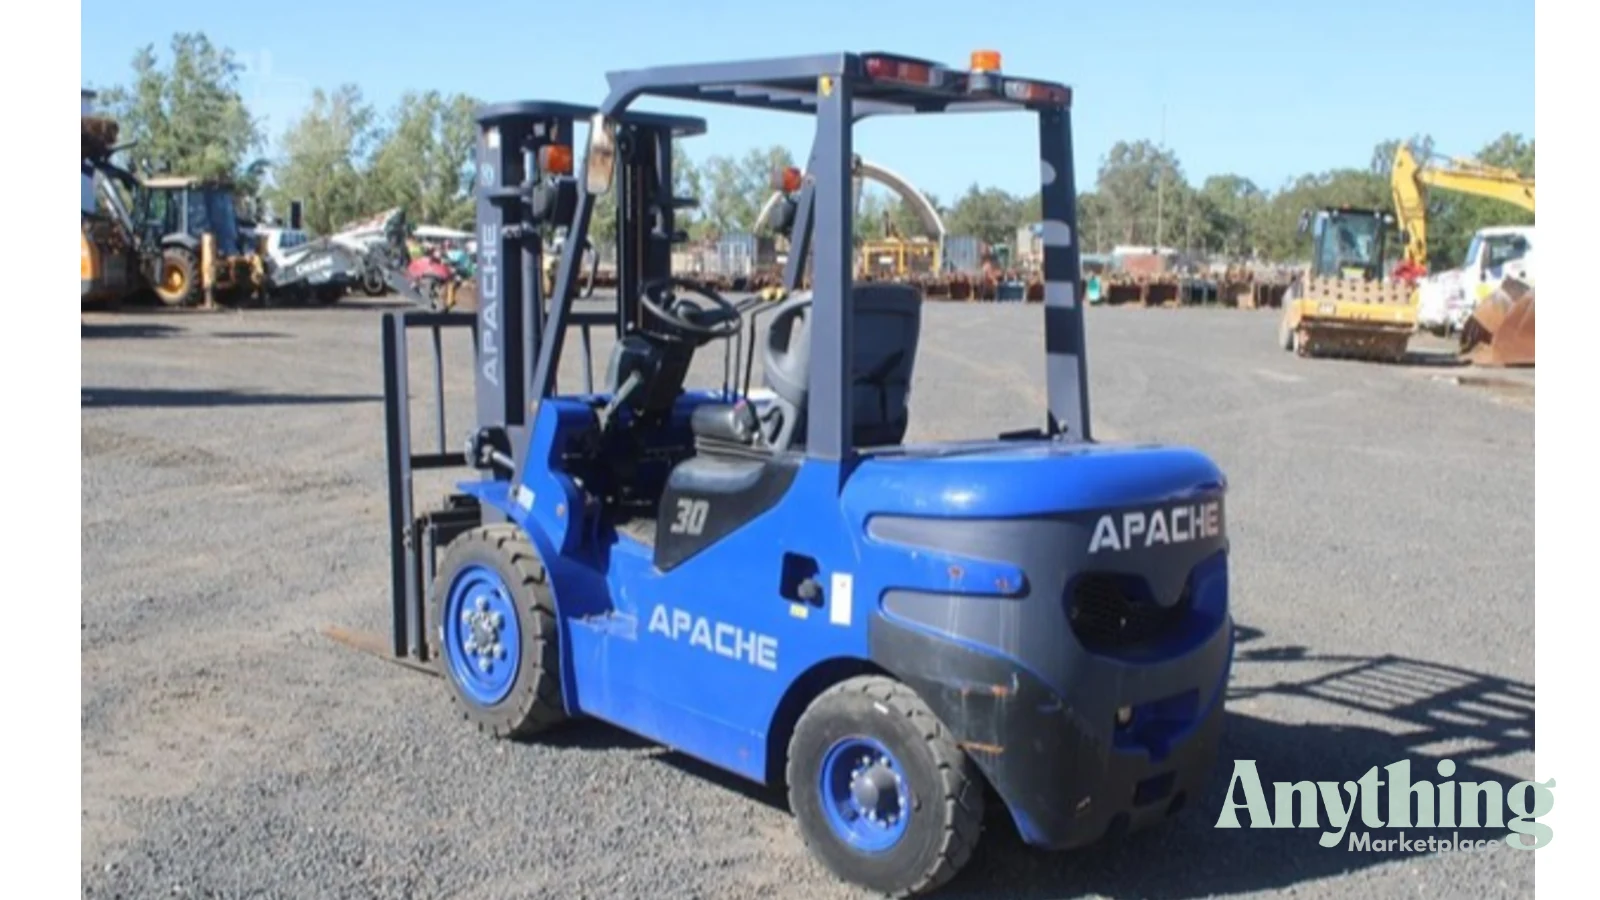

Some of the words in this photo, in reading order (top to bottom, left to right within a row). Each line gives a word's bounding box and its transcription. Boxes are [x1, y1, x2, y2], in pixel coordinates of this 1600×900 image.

[482, 224, 498, 386] APACHE
[670, 498, 709, 535] 30
[1088, 502, 1219, 553] APACHE
[648, 603, 778, 671] APACHE
